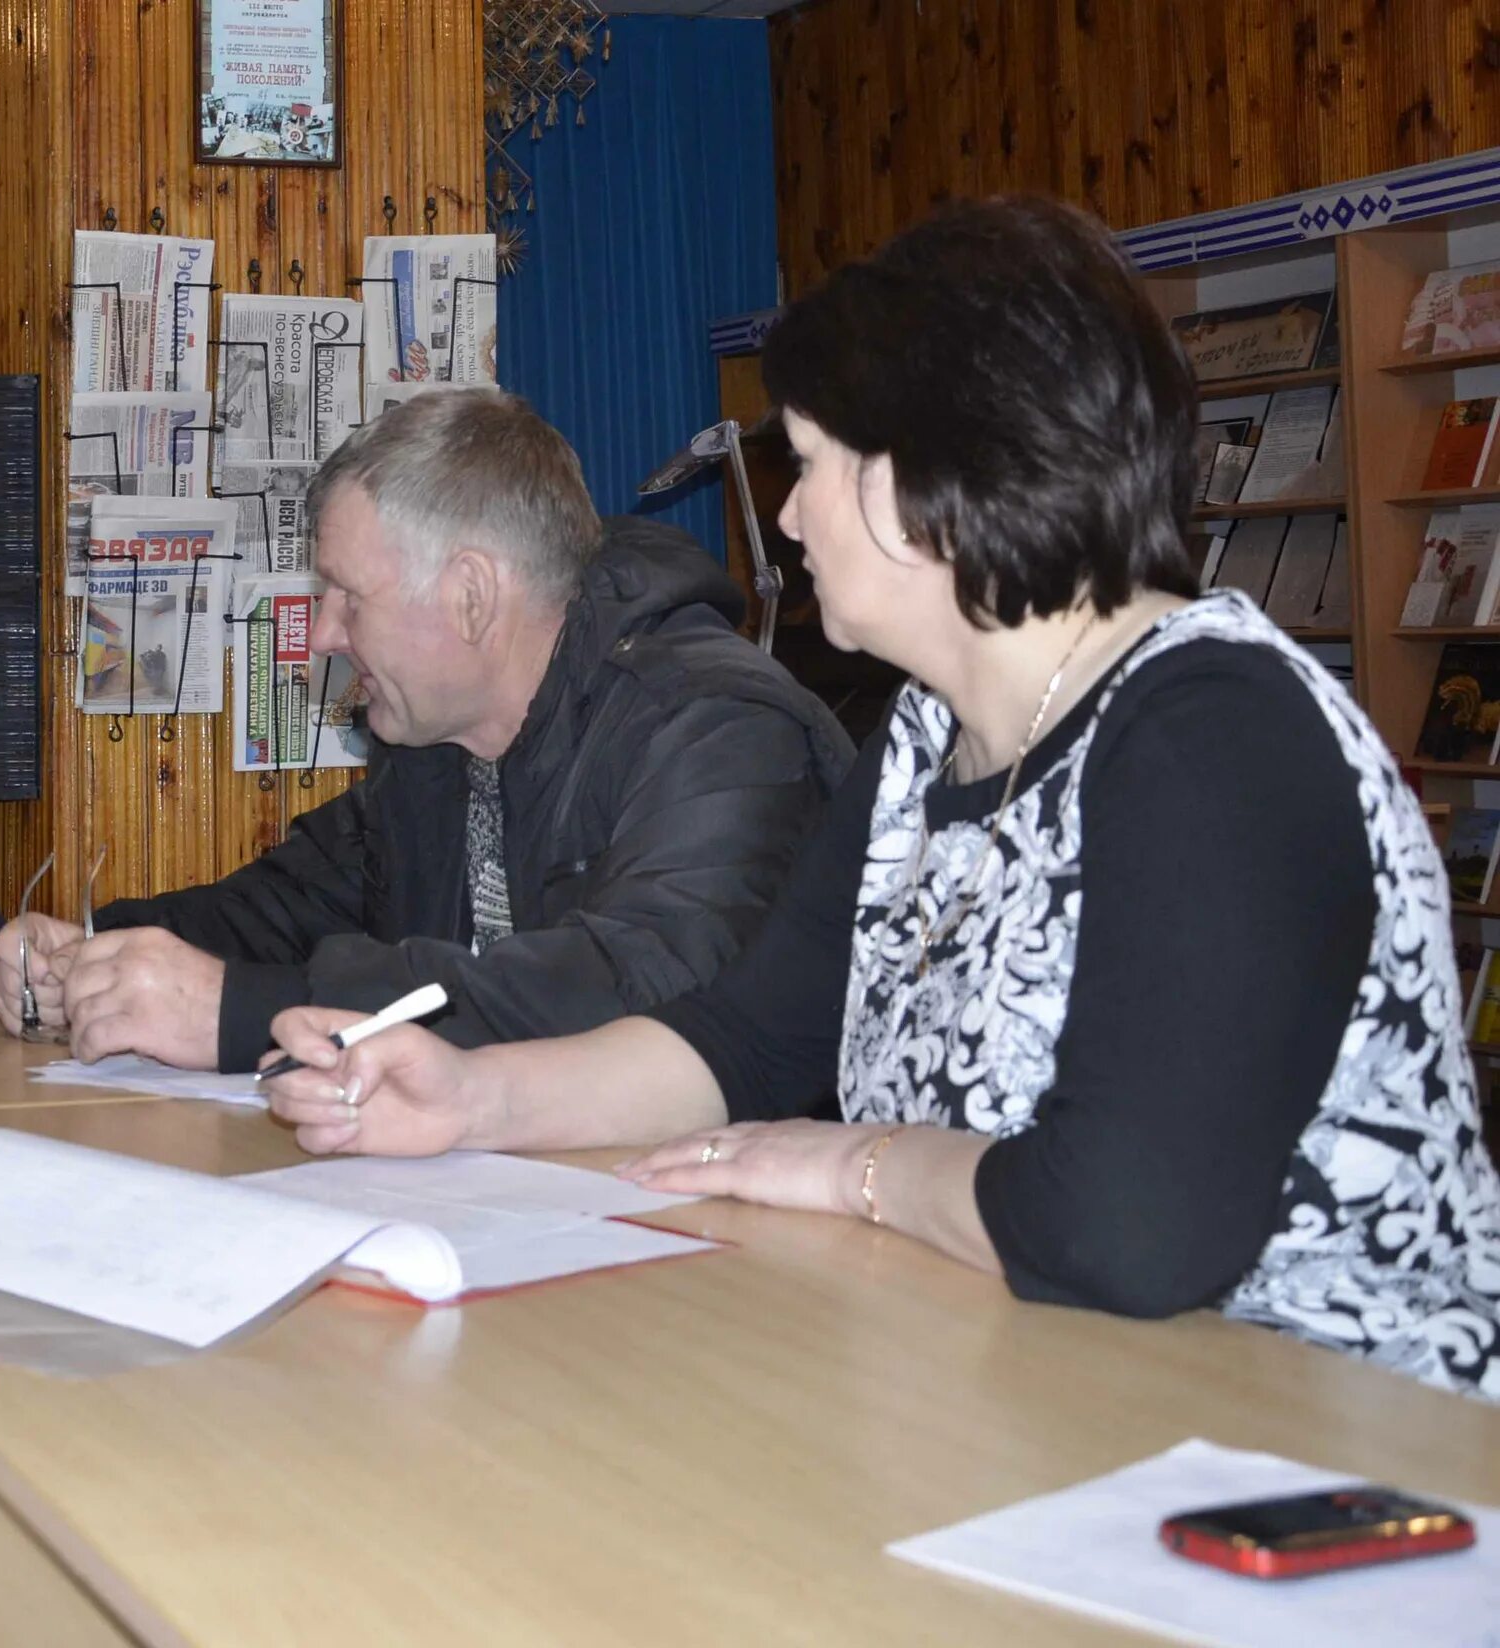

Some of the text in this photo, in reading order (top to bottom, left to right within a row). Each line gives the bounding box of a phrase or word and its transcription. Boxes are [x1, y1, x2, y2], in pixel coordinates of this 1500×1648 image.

[268, 63, 312, 75] ПАМЯТЬ
[290, 313, 306, 374] Красота
[272, 313, 288, 436] по-венесуэльски
[278, 499, 296, 528] ВСЕХ
[89, 536, 209, 564] ЗВЯЗДА
[151, 579, 168, 593] 3D
[278, 604, 288, 652] НАРОДНАЯ
[289, 604, 308, 652] ГАЗЕТА
[250, 672, 258, 726] НЯДЗЕЛЮ
[259, 668, 268, 735] СВЯТКУЮЦЬ
